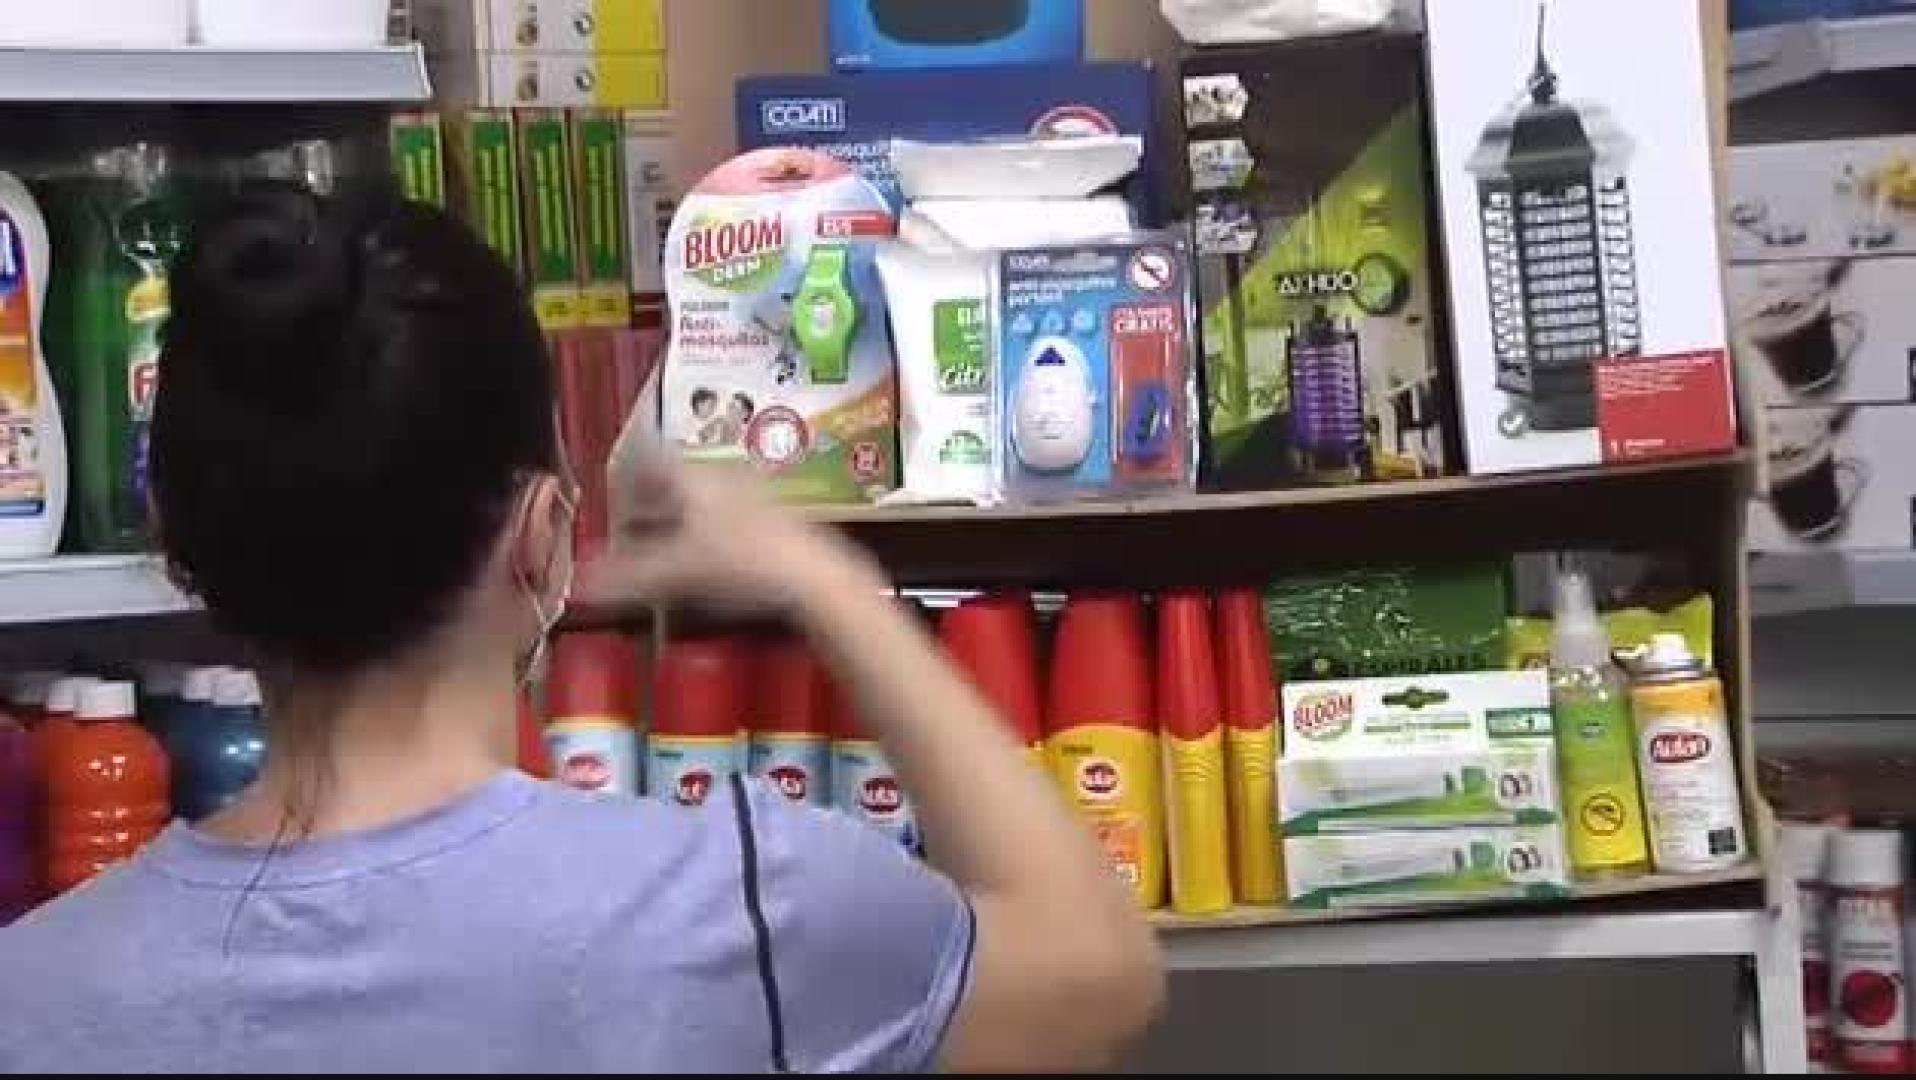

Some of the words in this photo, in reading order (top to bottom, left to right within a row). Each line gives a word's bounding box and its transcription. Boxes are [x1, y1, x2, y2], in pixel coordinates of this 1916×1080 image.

[768, 104, 837, 126] COATI
[685, 211, 783, 270] BLOOM
[1293, 693, 1354, 730] BLOOM
